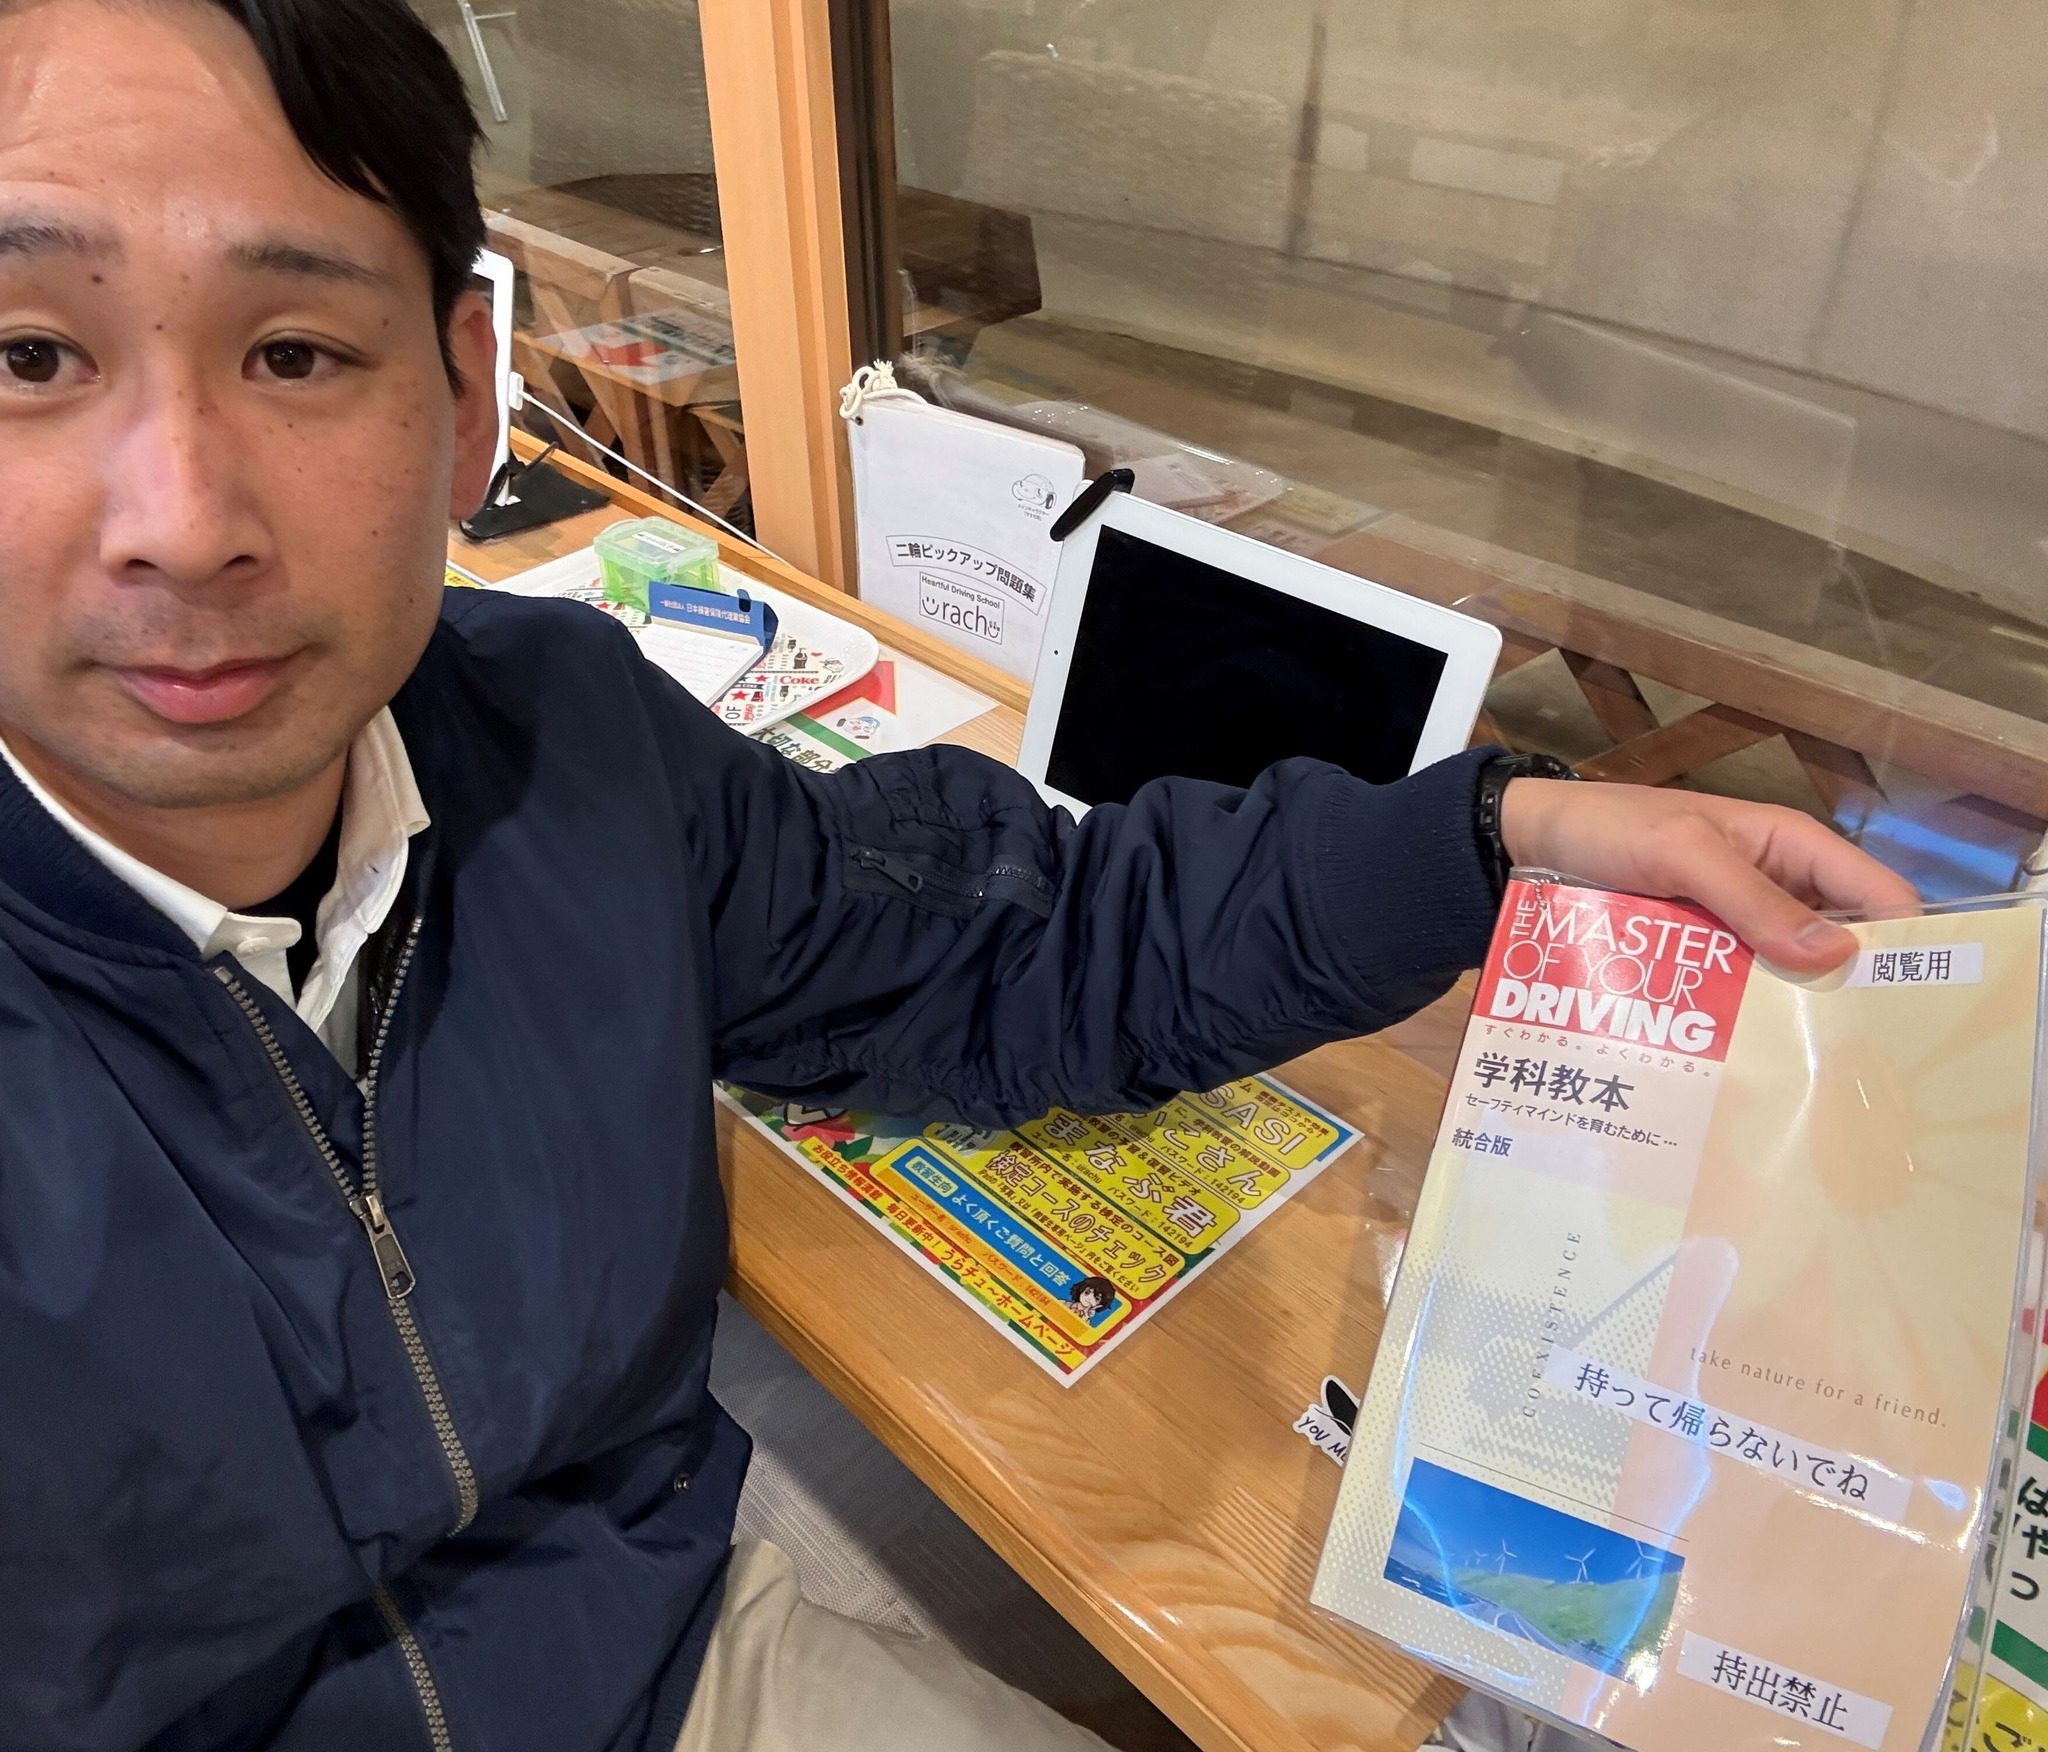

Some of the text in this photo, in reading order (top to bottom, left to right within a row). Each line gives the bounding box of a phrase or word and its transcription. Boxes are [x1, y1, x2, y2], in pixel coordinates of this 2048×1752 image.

[895, 541, 1037, 603] 二輪ピックアップ問題集
[921, 575, 1001, 609] Heartful Driving School
[779, 675, 820, 685] Coke
[750, 726, 840, 772] 大切な部分
[1509, 899, 1739, 974] THE MASTER
[1871, 949, 1953, 984] 閲覧用
[1503, 941, 1705, 1009] OF YOUR
[1489, 978, 1717, 1052] DRIVING
[1473, 1051, 1635, 1114] 学科教本
[1042, 1108, 1219, 1240] まなぶ君
[1452, 1127, 1514, 1159] 統合版
[951, 1191, 1072, 1288] よく頂くご質問と回答
[985, 1148, 1168, 1288] 検定コースのチェック
[1690, 1346, 1949, 1429] take nature for a friend.
[1573, 1364, 1870, 1502] 持って帰らないでね
[1711, 1650, 1850, 1735] 持出禁止
